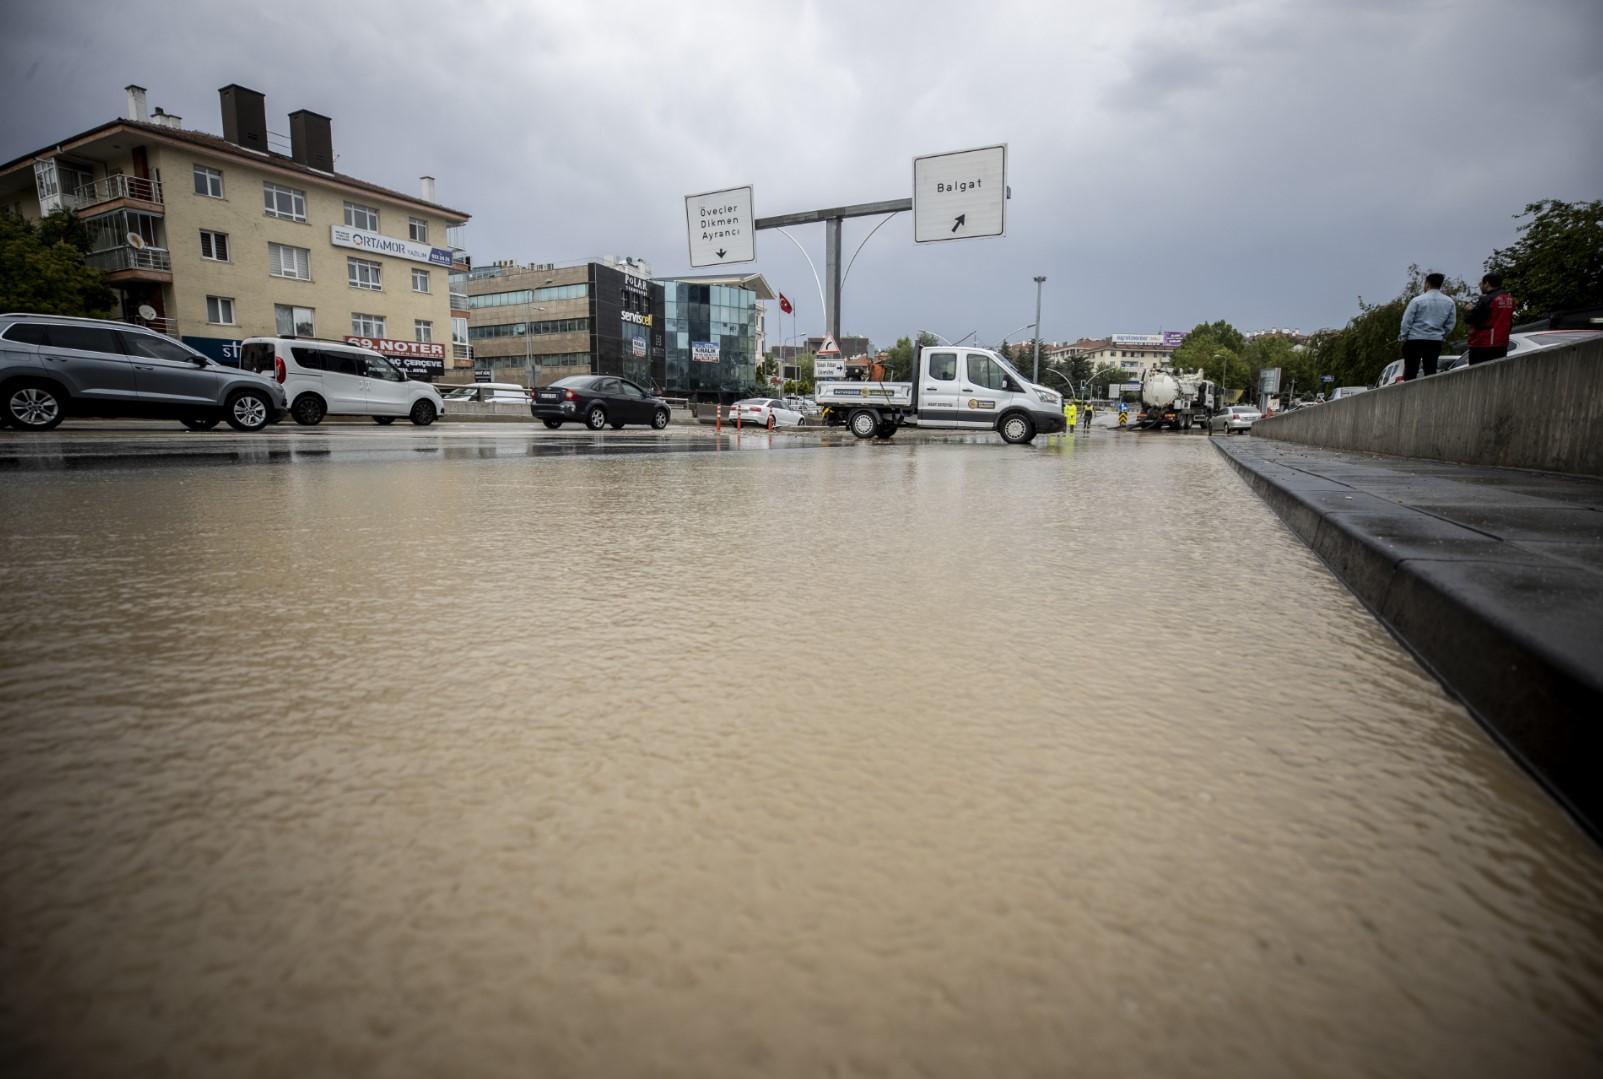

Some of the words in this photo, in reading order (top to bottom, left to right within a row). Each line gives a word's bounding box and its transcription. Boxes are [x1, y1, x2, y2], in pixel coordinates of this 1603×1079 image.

[937, 178, 984, 193] Balgat
[701, 217, 739, 229] Dikmen
[702, 229, 740, 241] Ayrancı
[352, 233, 406, 254] ORTAMOR
[620, 310, 653, 328] serviscell
[403, 359, 443, 368] ÇERÇEVE
